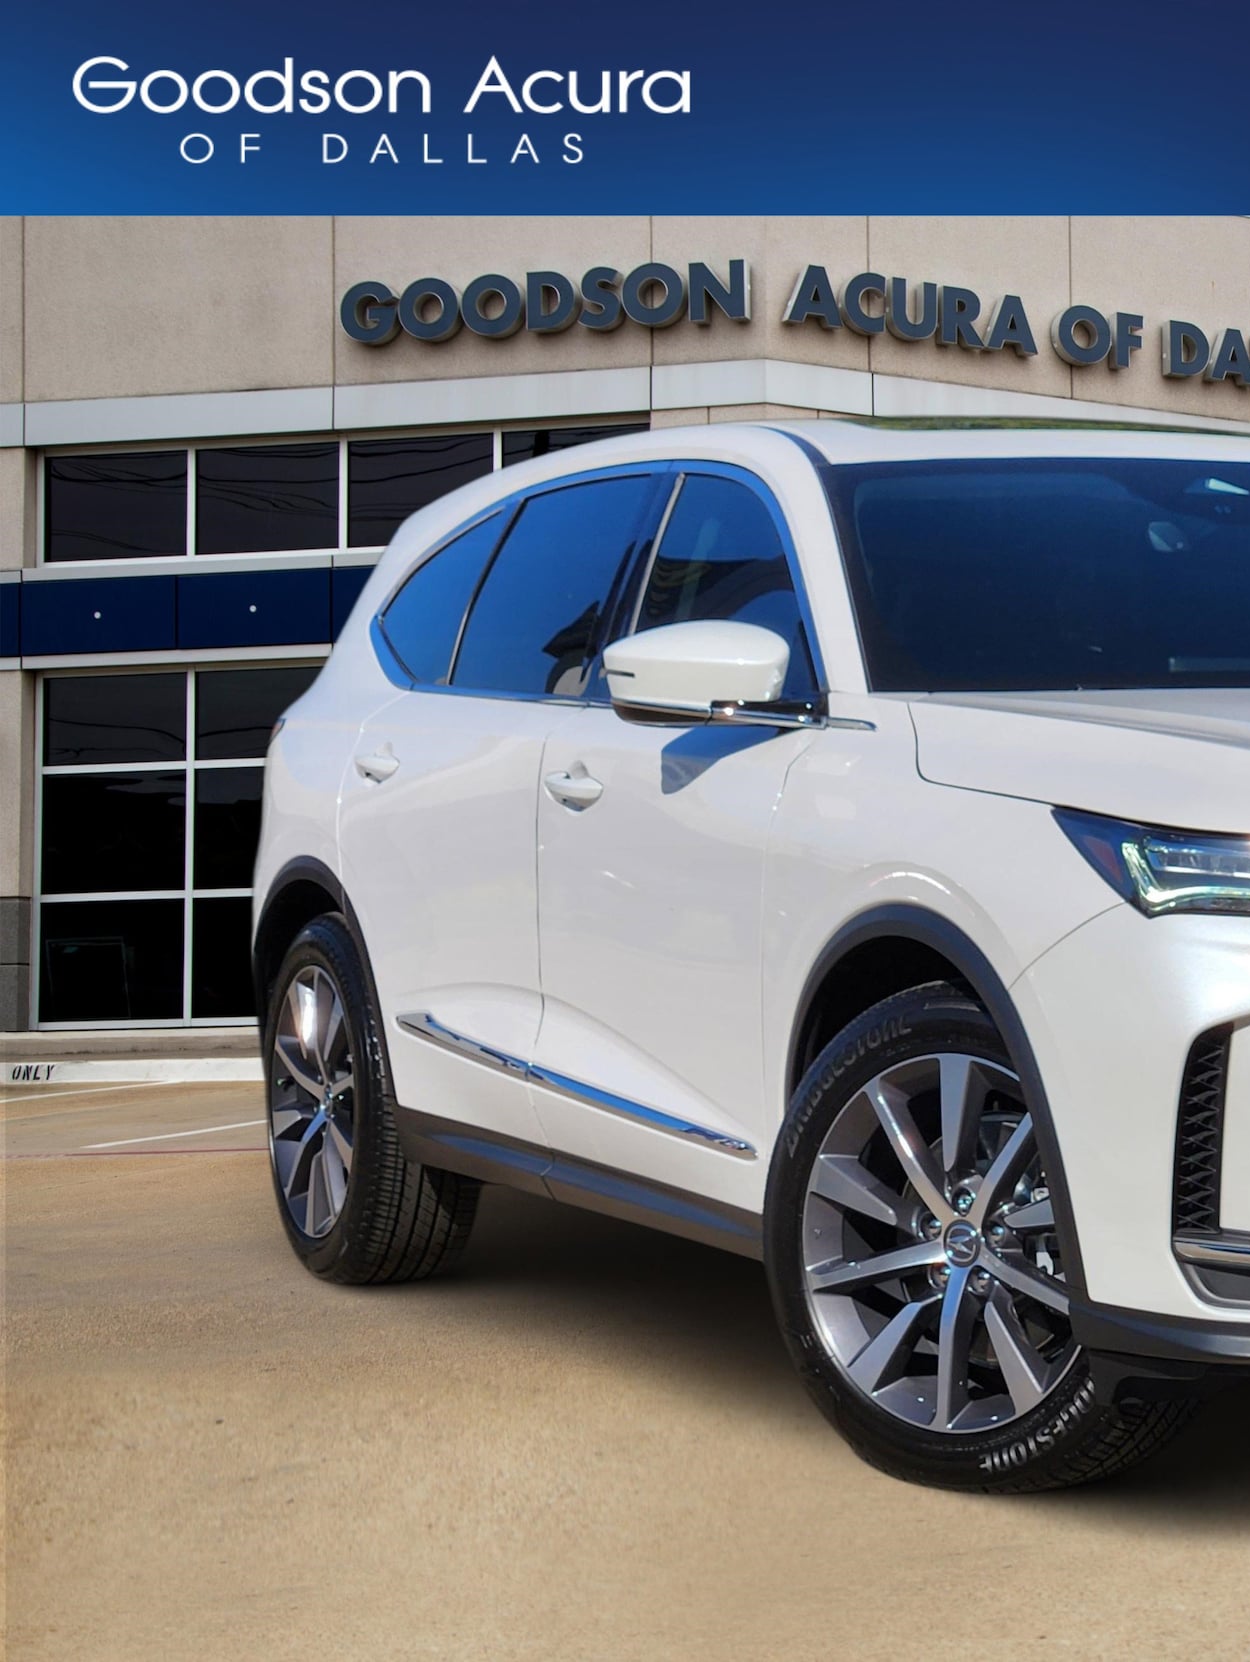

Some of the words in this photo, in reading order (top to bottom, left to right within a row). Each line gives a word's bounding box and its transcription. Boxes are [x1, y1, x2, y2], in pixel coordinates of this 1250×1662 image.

[340, 259, 751, 345] GOODSON
[782, 264, 1038, 357] ACURA
[1051, 305, 1144, 370] OF
[12, 1064, 55, 1080] ONLY
